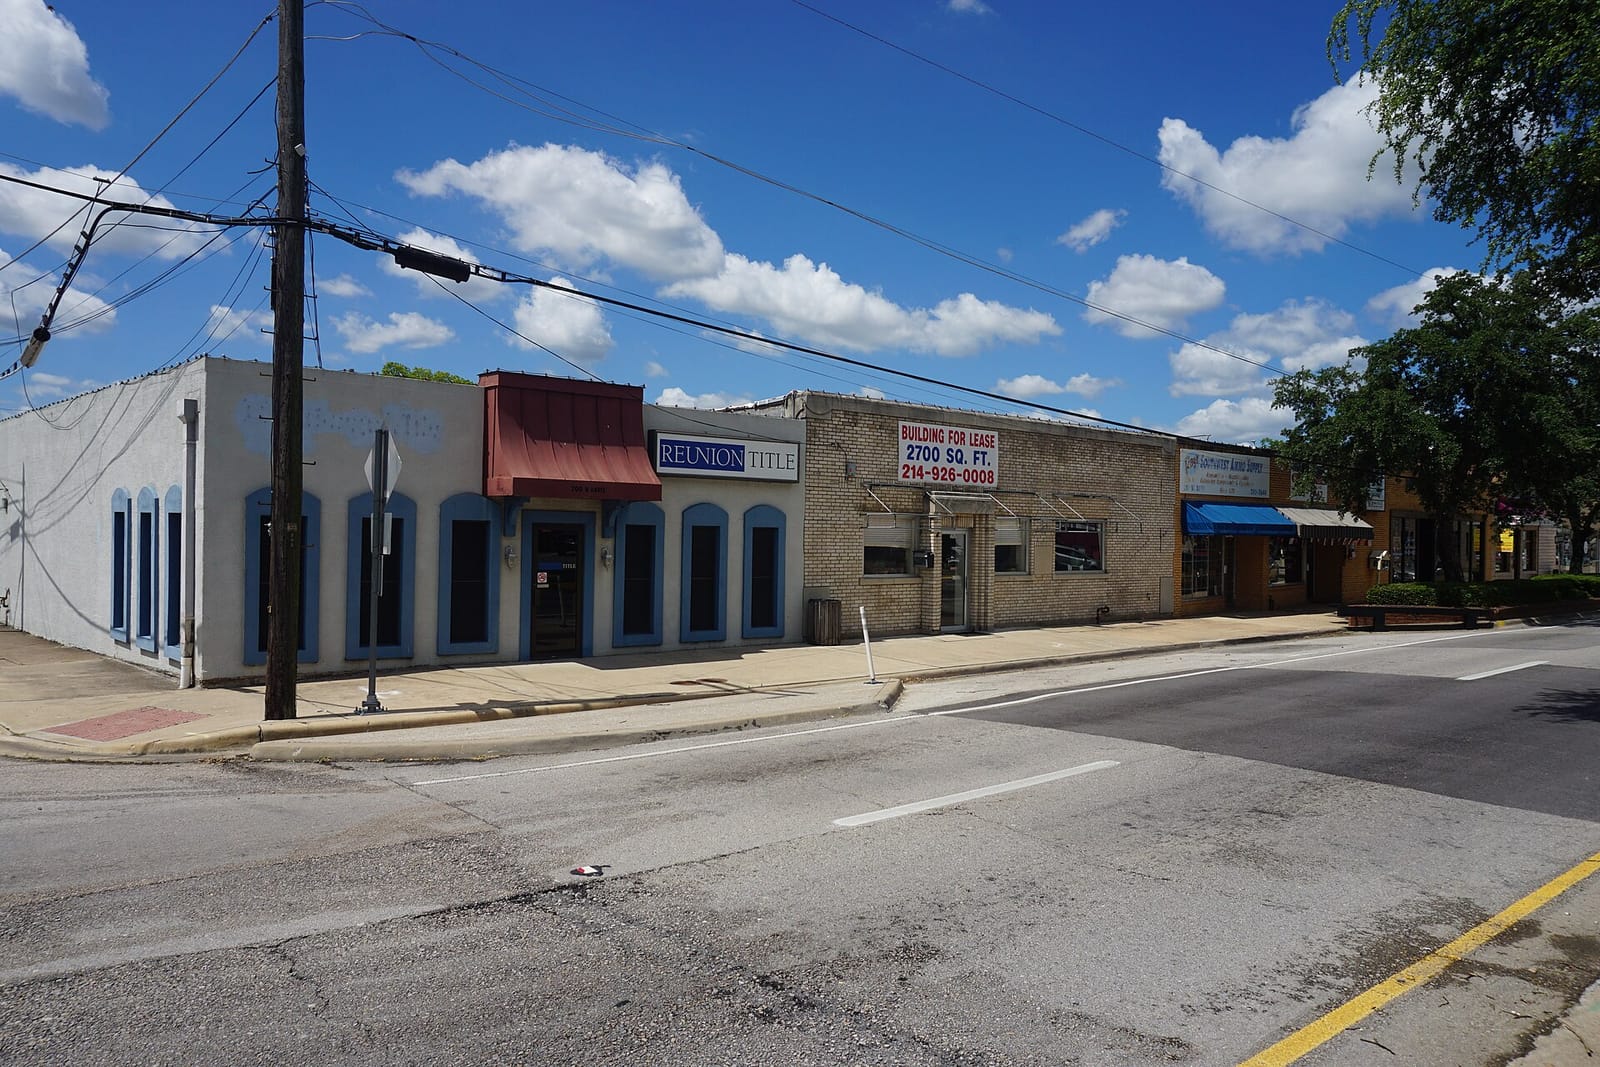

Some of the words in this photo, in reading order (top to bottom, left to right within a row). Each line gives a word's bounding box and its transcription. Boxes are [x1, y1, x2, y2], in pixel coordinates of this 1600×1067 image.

[902, 425, 935, 444] BUILDING
[948, 430, 966, 446] FOR
[969, 432, 995, 449] LEASE
[661, 444, 744, 467] REUNION
[748, 451, 795, 470] TITLE
[906, 444, 940, 462] 2700
[946, 447, 968, 465] SQ.
[973, 450, 991, 467] FT.
[902, 463, 995, 484] 214-926-0008
